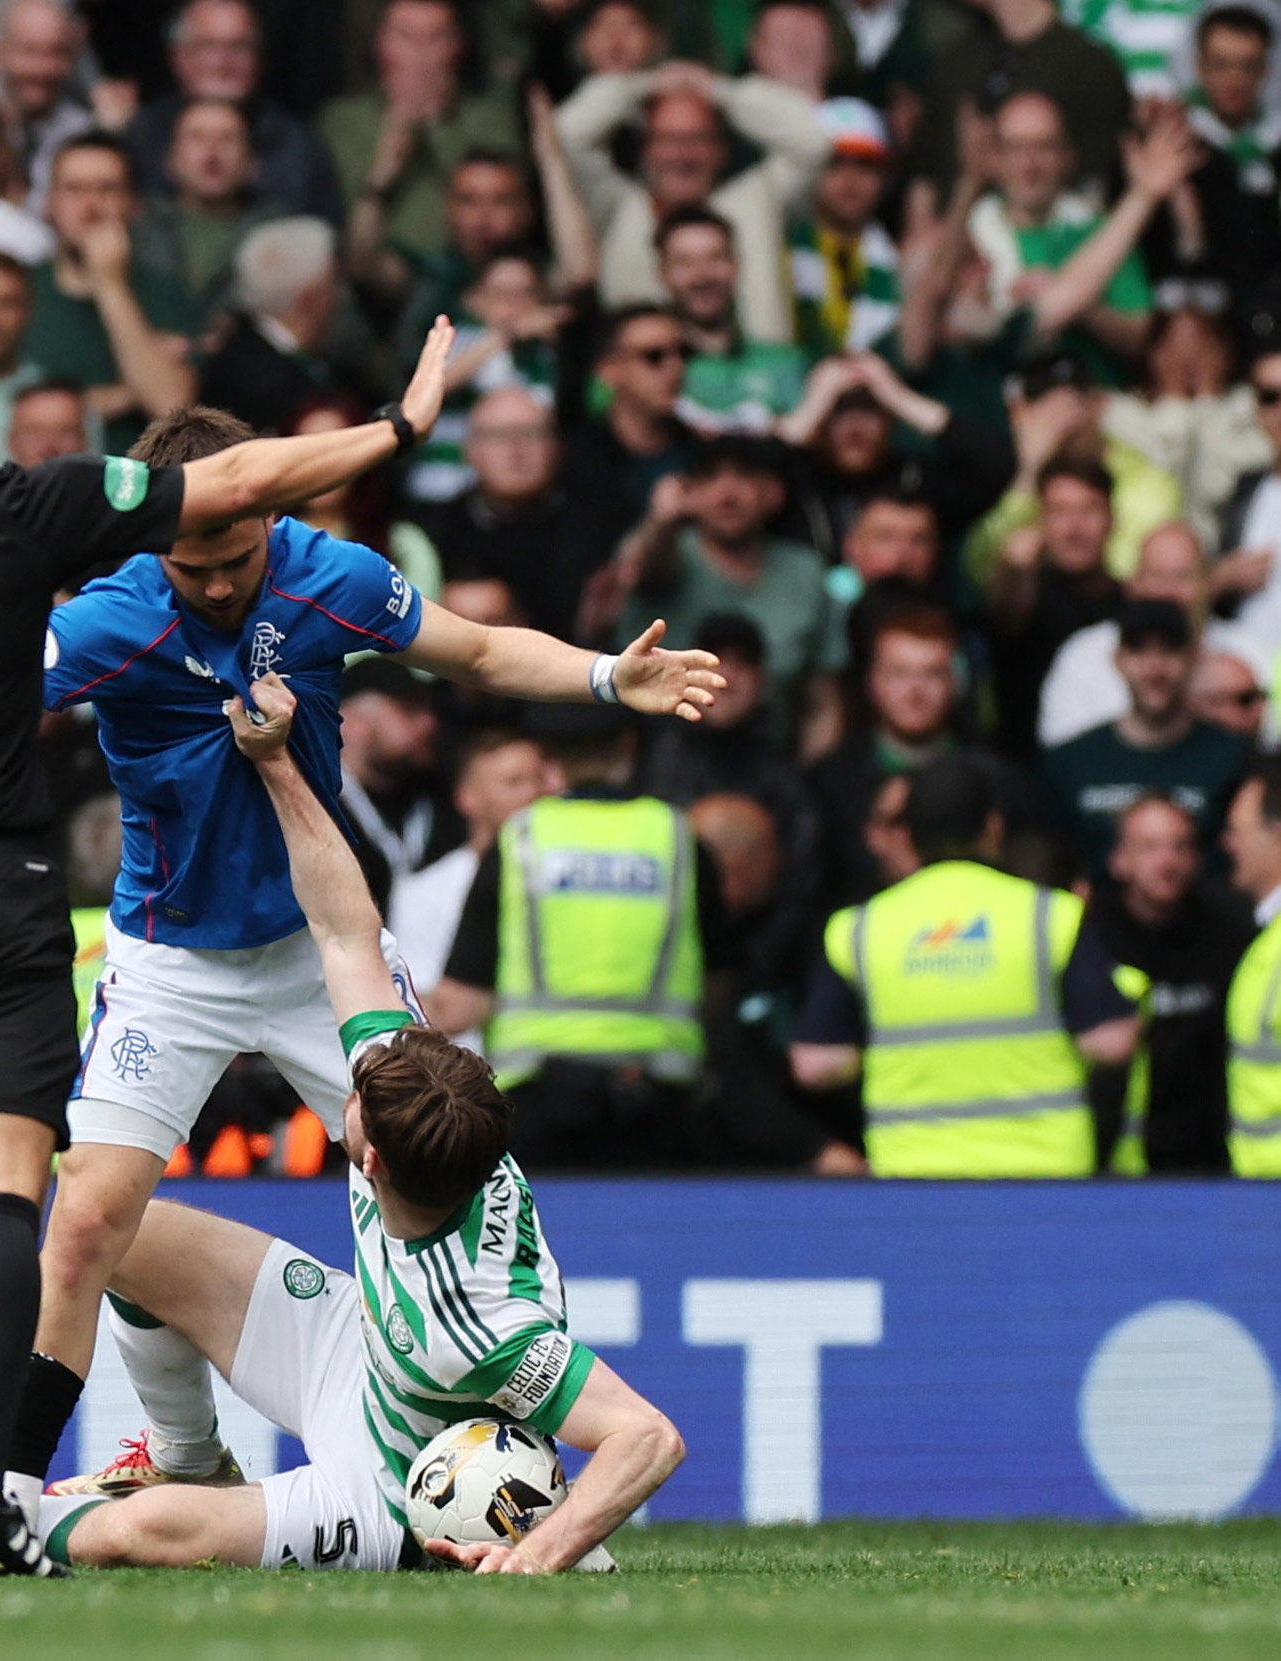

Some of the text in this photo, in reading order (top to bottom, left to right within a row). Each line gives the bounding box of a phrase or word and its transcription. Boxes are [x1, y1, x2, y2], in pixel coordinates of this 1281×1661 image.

[506, 1338, 549, 1394] CELTIC FC
[522, 1336, 569, 1405] FOUNDATION
